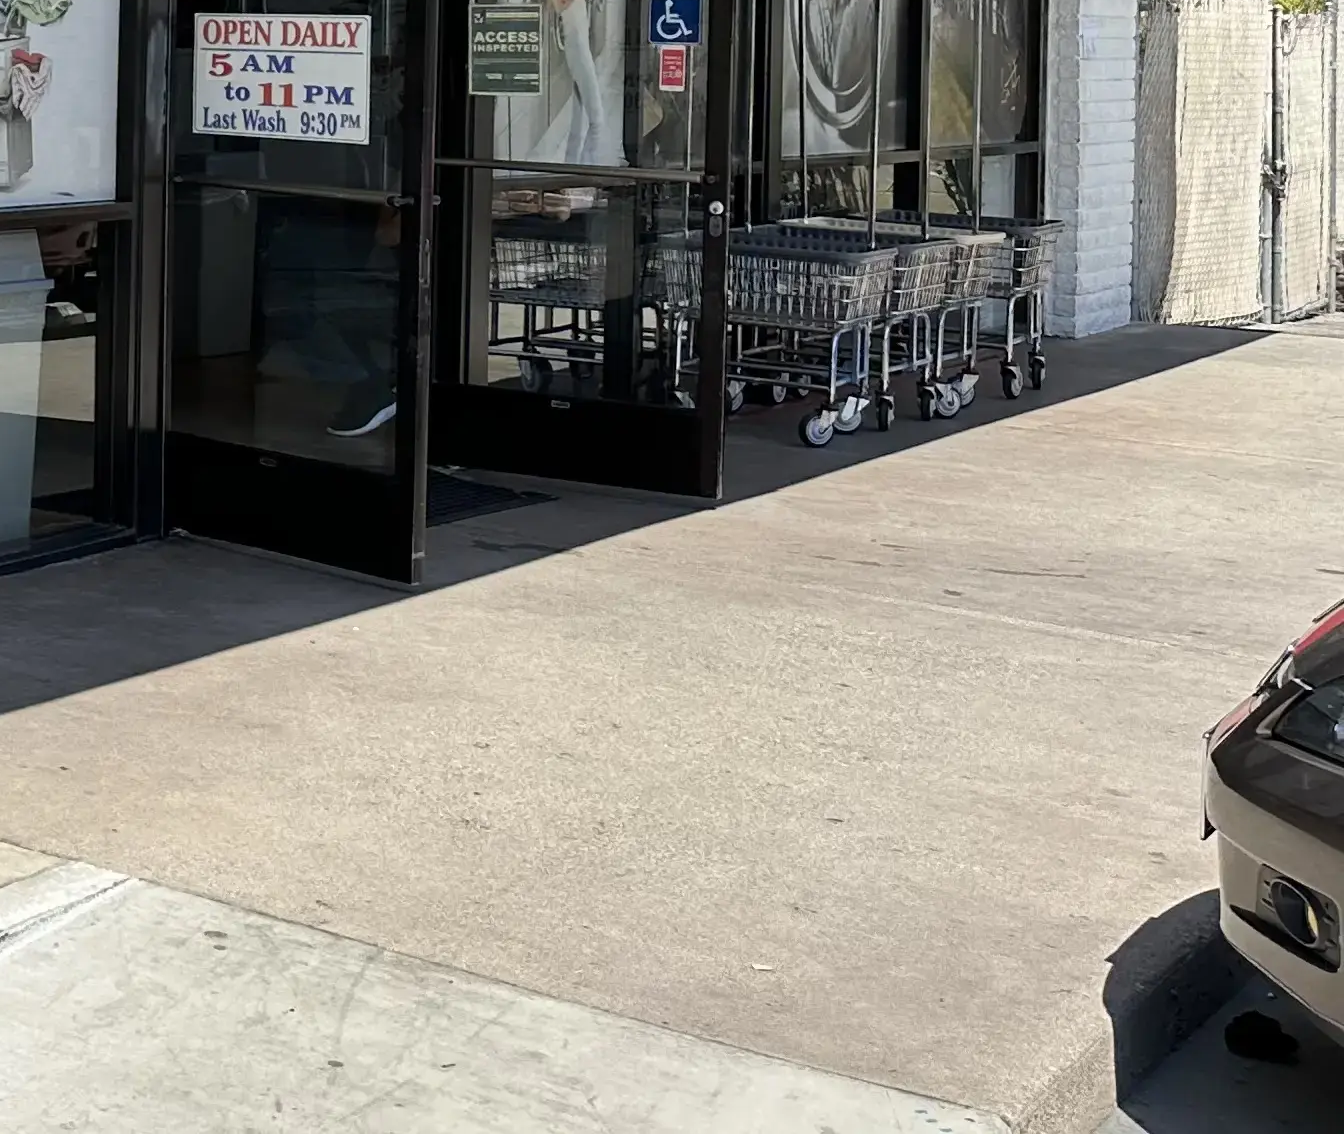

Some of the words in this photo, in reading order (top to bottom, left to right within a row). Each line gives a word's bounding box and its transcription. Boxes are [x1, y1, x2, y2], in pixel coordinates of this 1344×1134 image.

[202, 18, 273, 47] OPEN
[280, 20, 363, 48] DAILY
[473, 31, 539, 43] ACCESS
[473, 44, 539, 53] INSPECTED
[208, 52, 233, 77] 5
[240, 53, 296, 74] AM
[223, 80, 251, 102] to
[257, 82, 299, 109] 11
[302, 84, 355, 106] PM
[202, 106, 238, 130] Last
[241, 107, 287, 134] Wash
[300, 110, 338, 137] 9:30
[339, 112, 362, 130] PM
